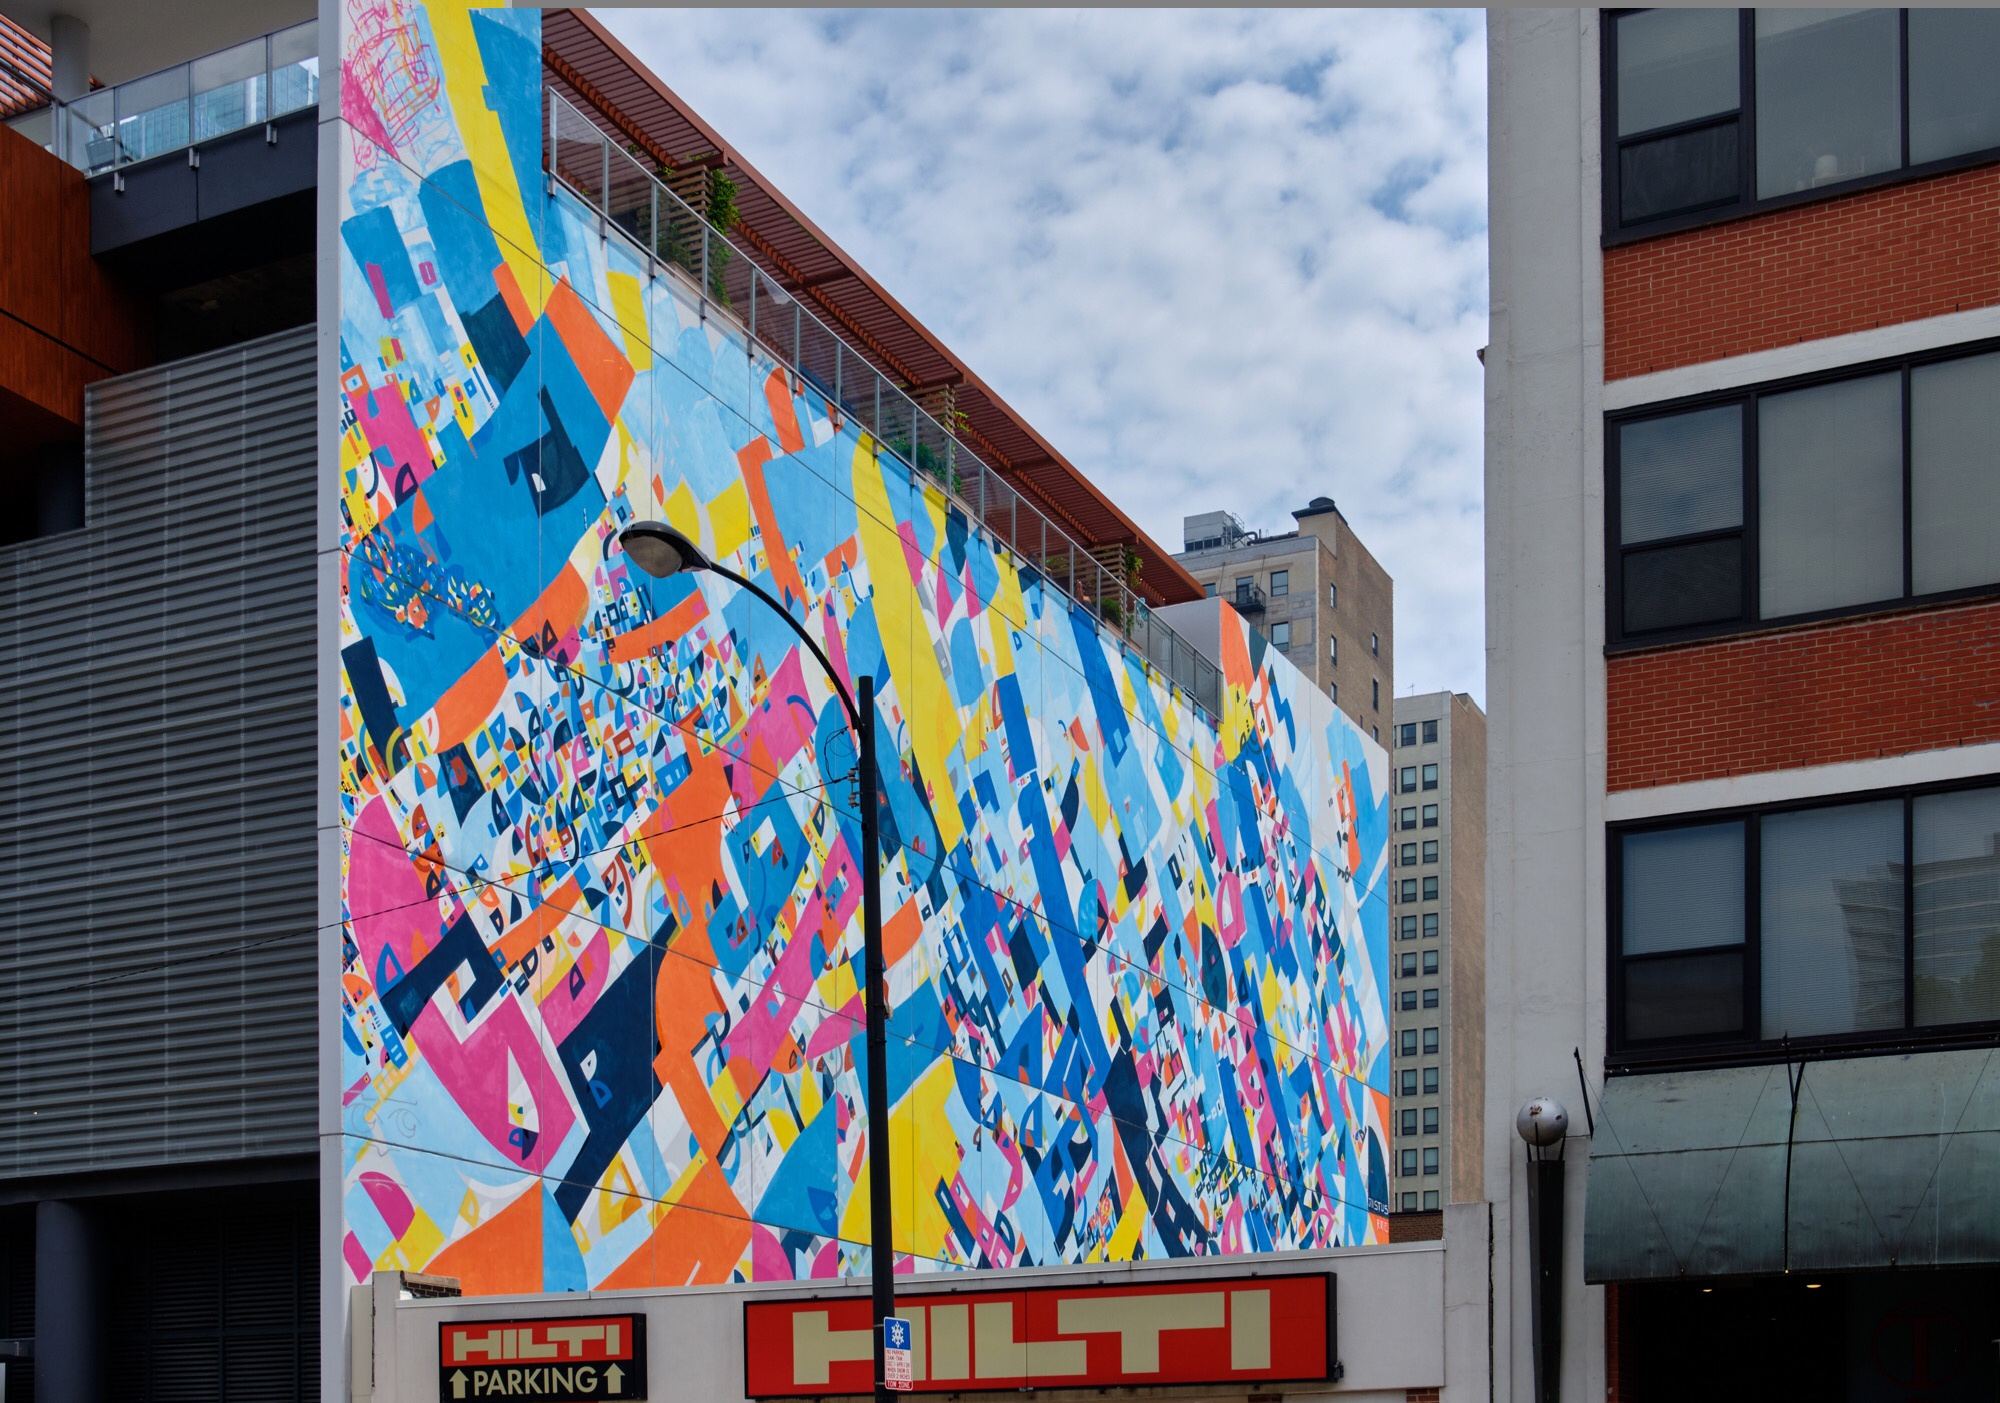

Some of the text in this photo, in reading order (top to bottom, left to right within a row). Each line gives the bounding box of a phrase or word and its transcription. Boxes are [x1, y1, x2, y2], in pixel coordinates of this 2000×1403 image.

[453, 1324, 620, 1361] HILTI
[792, 1289, 1271, 1385] HILTI
[474, 1366, 598, 1396] PARKING
